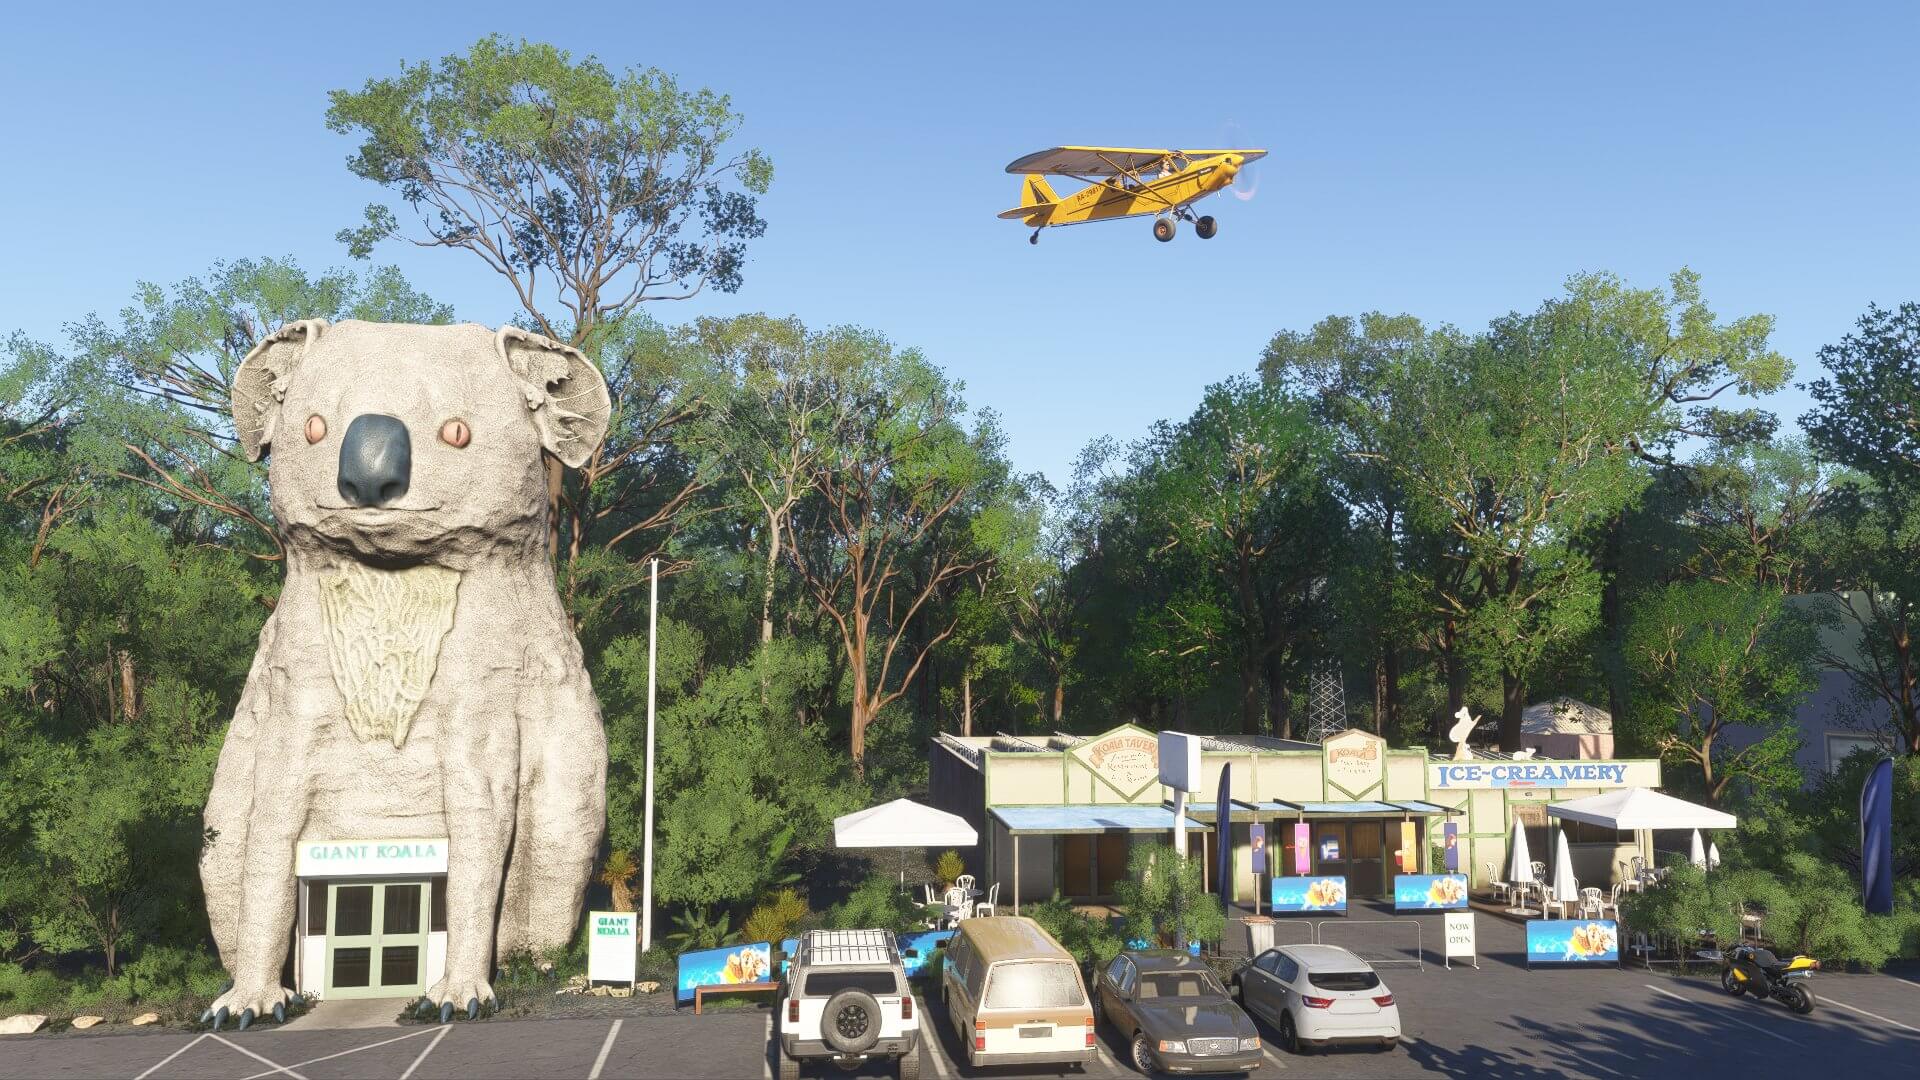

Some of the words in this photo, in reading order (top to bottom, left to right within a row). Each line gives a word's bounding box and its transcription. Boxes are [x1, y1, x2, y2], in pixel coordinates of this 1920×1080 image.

[1092, 738, 1123, 754] KOALA
[1125, 738, 1156, 753] TAVER
[1438, 765, 1627, 787] ICE-CREAMERY
[310, 846, 368, 860] GIANT
[376, 845, 437, 858] KOALA
[598, 917, 629, 926] GIANT
[1450, 922, 1469, 931] NOW
[597, 927, 631, 936] KOALA
[1449, 936, 1471, 944] OPEN
